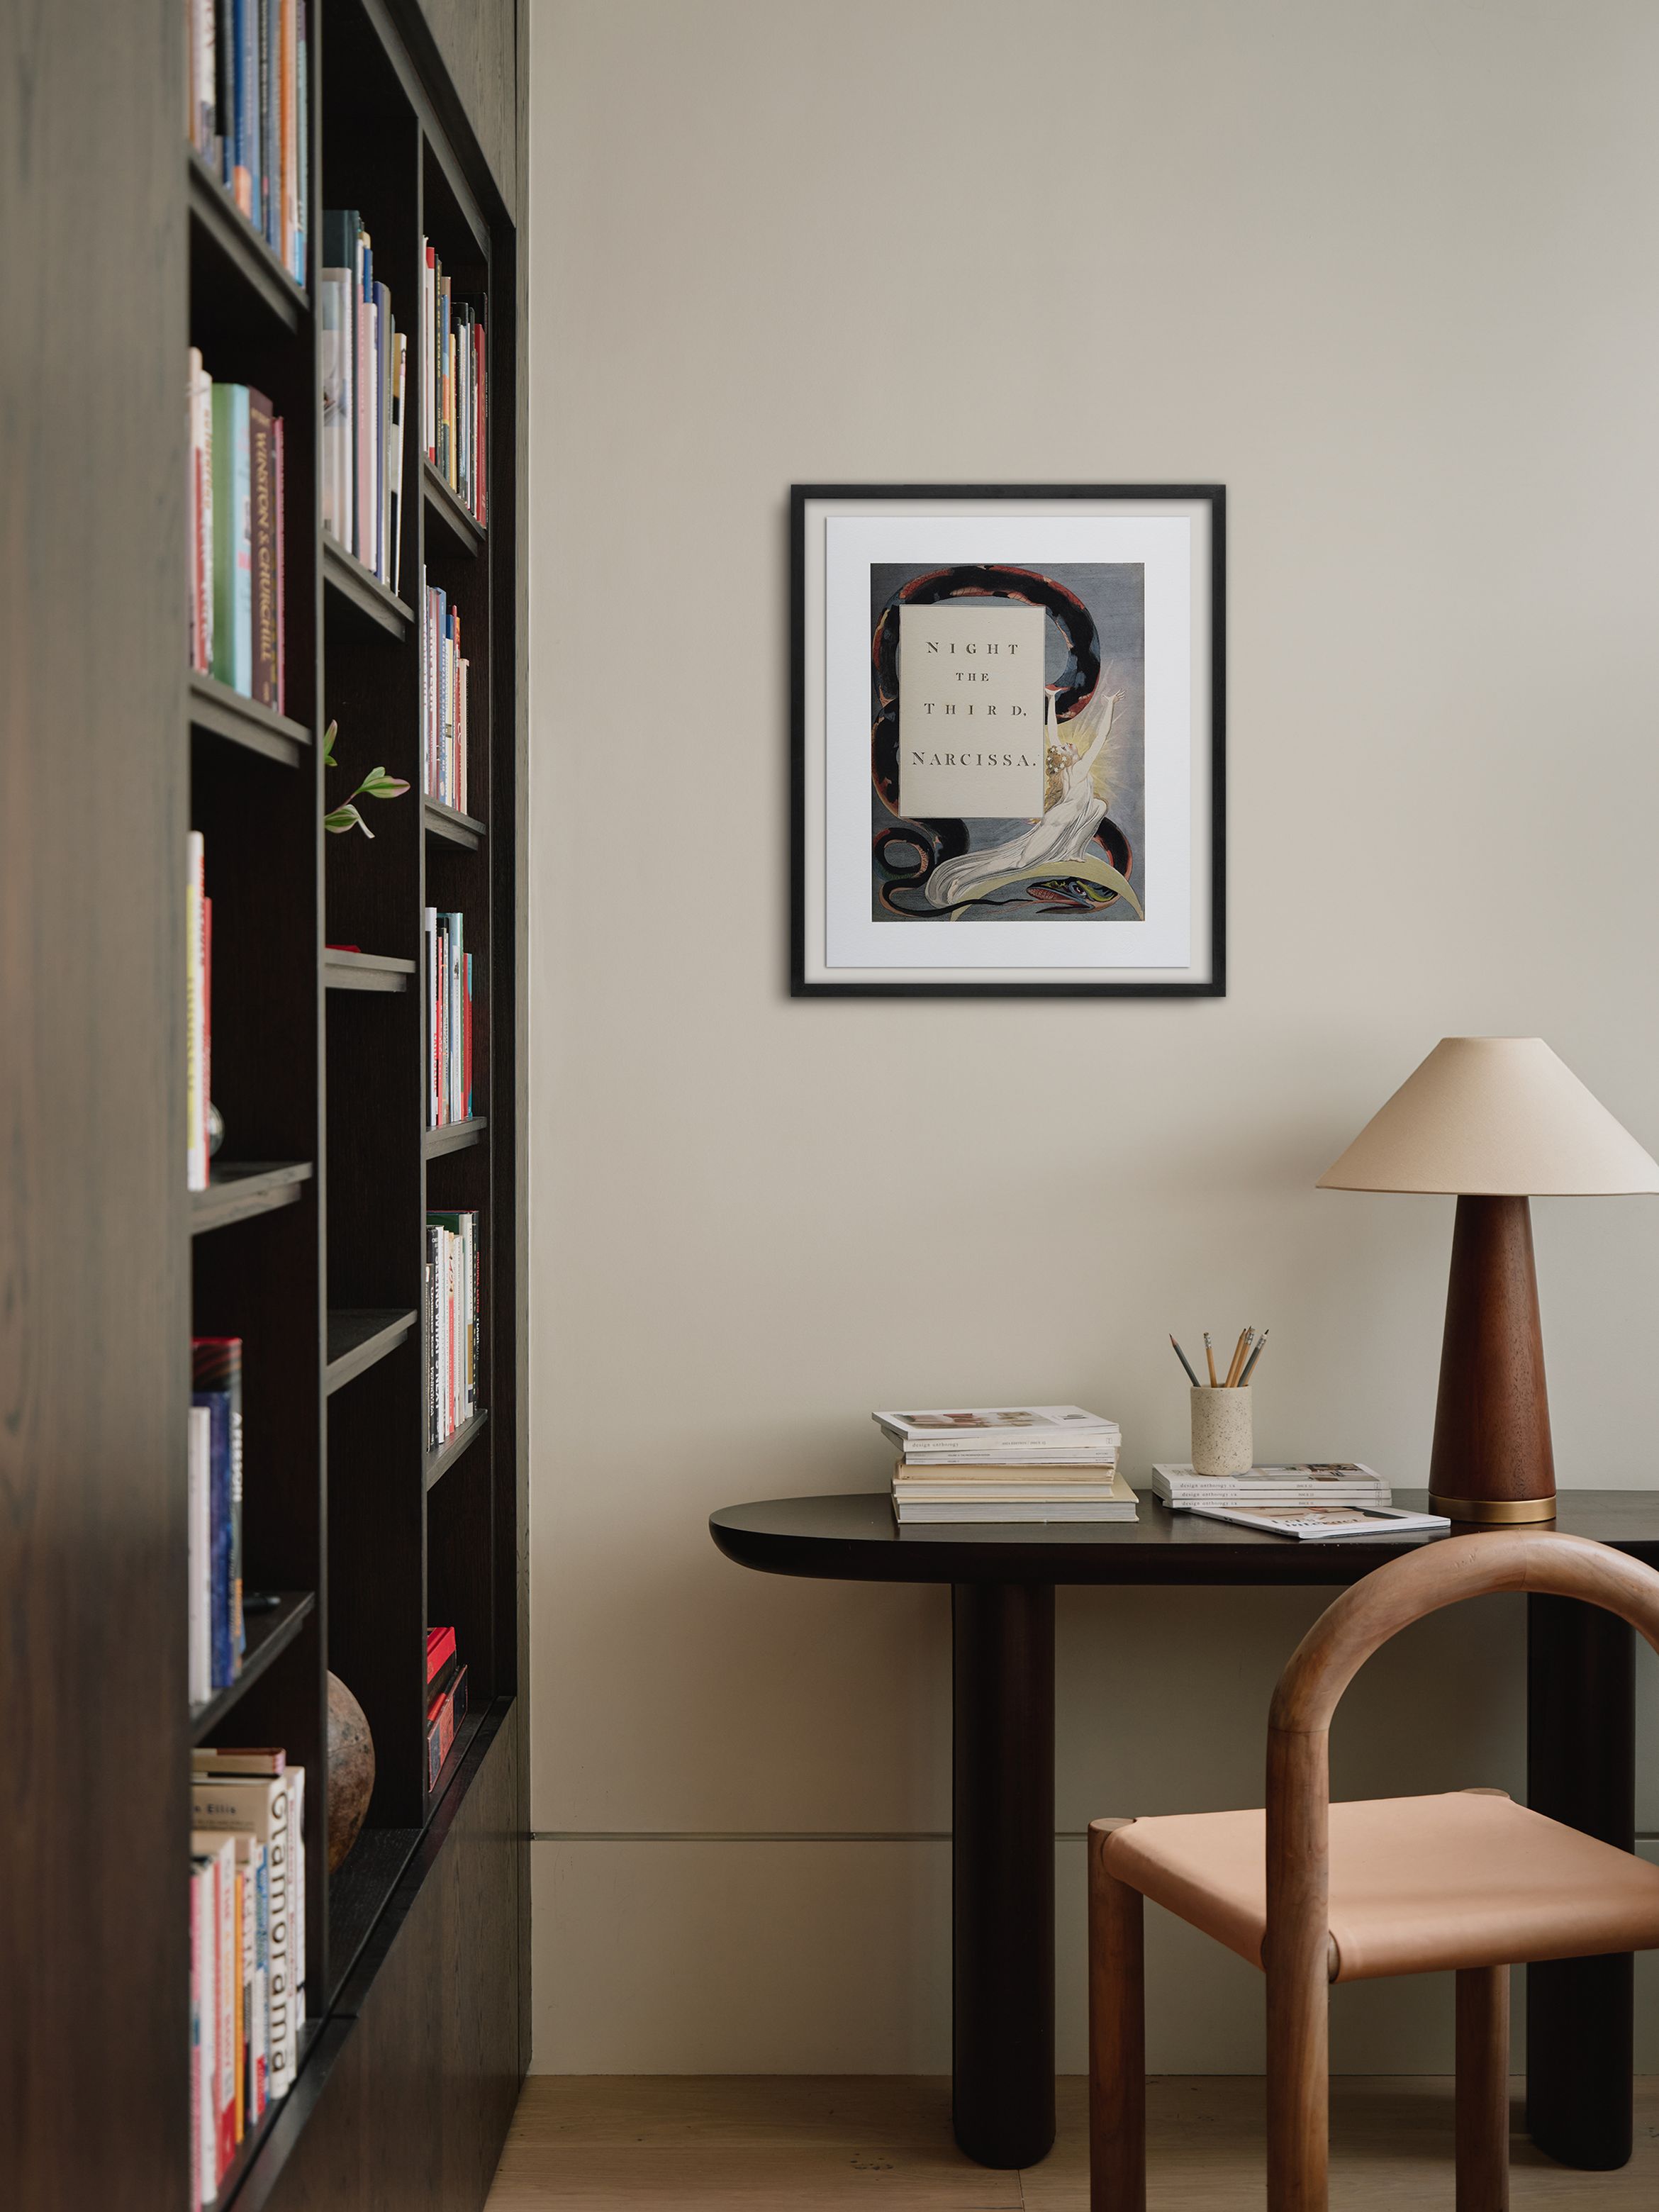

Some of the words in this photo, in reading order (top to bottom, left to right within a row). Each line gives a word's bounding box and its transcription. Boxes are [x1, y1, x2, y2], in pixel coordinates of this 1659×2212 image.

[256, 432, 269, 528] WINSTON
[258, 547, 271, 662] CHURCHILL
[927, 642, 1018, 655] NIGHT
[956, 672, 990, 681] THE
[912, 752, 1037, 766] NARCISSA.
[207, 1803, 237, 1814] Ellis
[271, 1791, 289, 2074] Glamorama
